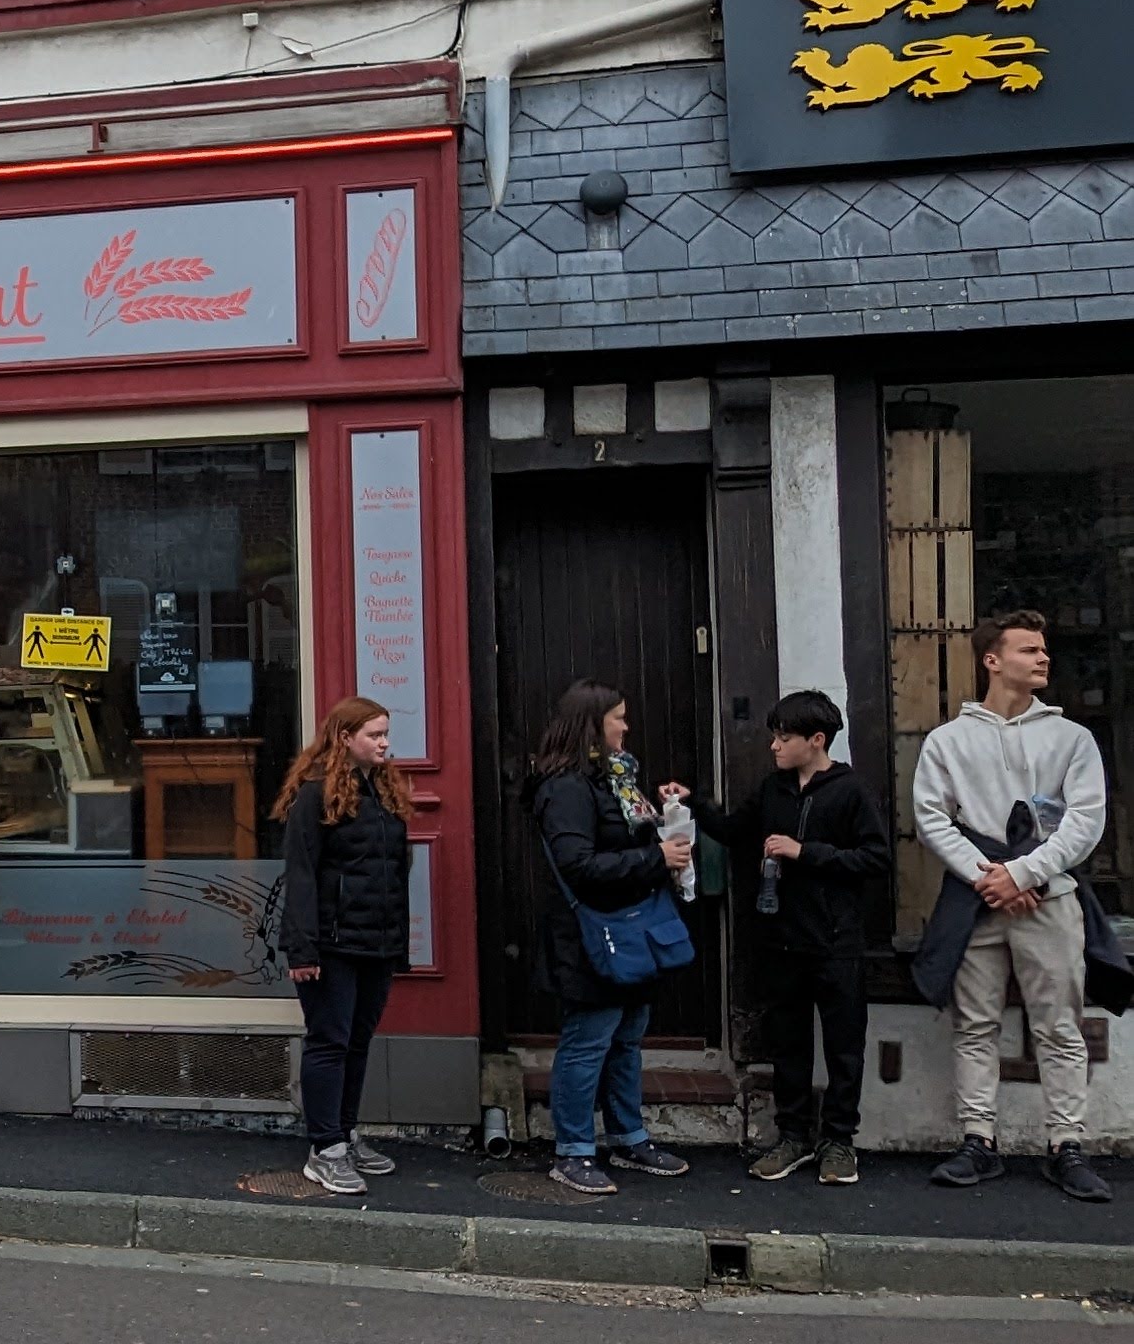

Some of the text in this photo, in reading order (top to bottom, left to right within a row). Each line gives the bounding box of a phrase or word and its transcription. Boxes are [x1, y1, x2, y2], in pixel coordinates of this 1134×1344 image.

[594, 440, 605, 461] 2
[370, 570, 407, 586] Quiche
[365, 595, 413, 611] Baguette
[365, 632, 413, 649] Baguette
[373, 649, 405, 664] Pizza
[371, 672, 409, 688] Croque
[0, 908, 94, 926] Bienvenue
[127, 908, 188, 926] Etretat
[24, 930, 163, 944] Welcome to Etretat
